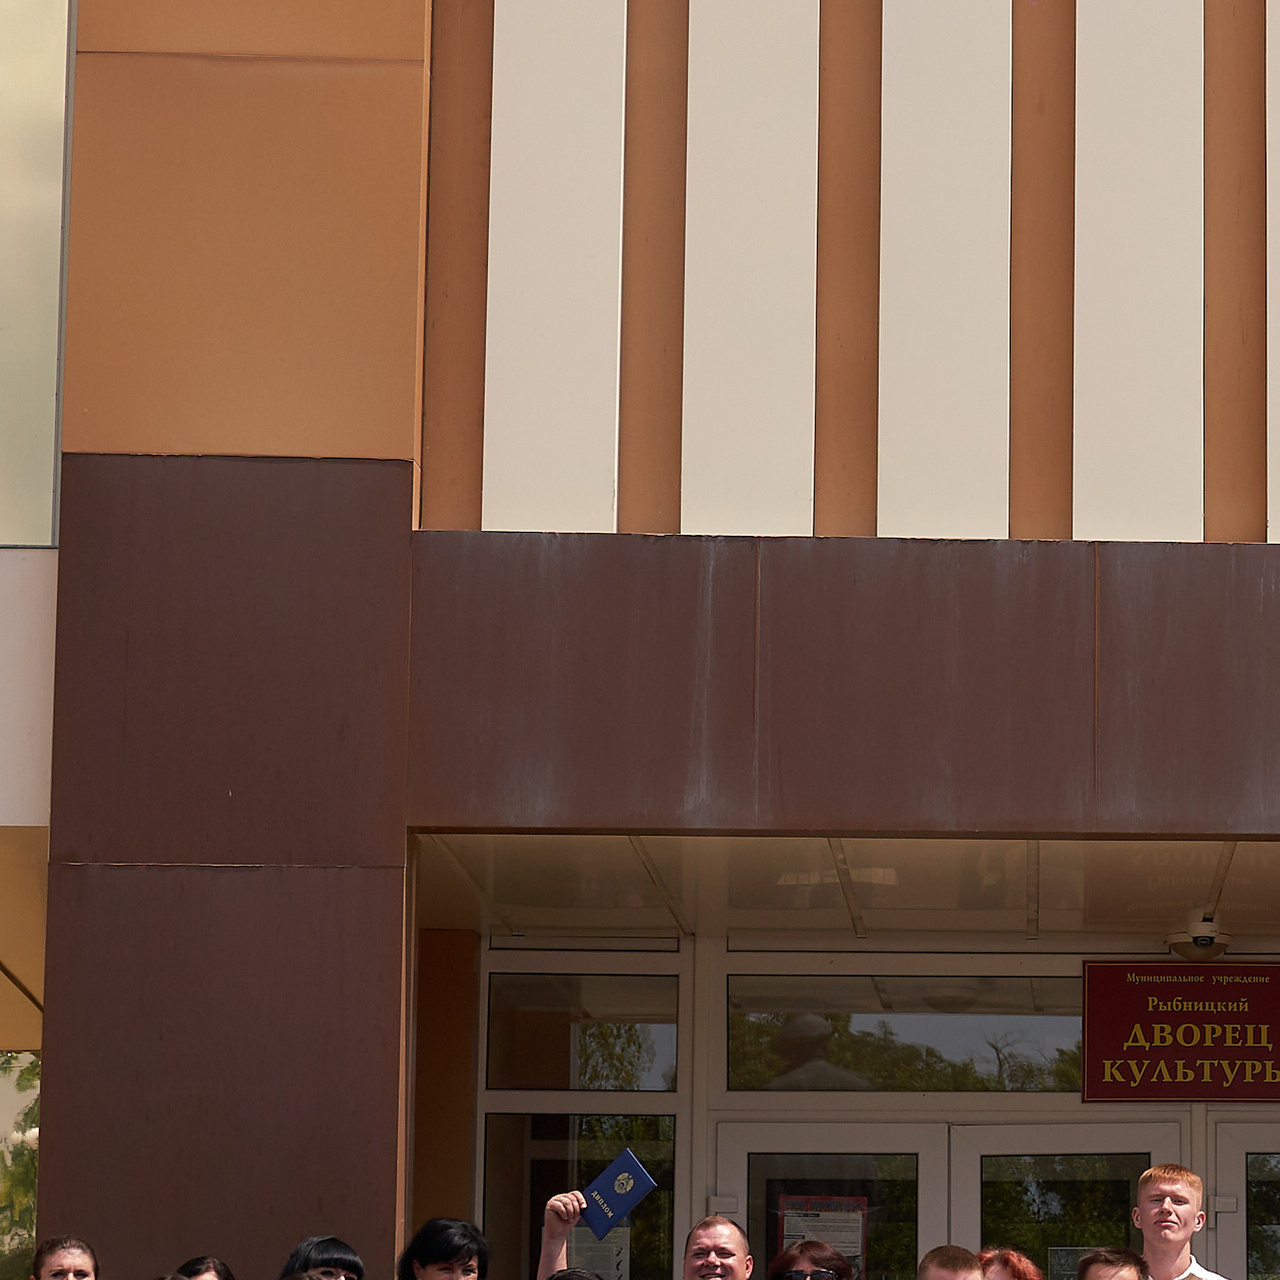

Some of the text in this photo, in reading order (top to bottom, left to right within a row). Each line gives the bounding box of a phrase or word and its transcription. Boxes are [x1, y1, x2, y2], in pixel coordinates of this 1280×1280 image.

[1126, 972, 1271, 985] Муниципальное учреждение
[1147, 996, 1250, 1014] Рыбницкий
[1122, 1023, 1274, 1052] ДВОРЕЦ
[590, 1190, 615, 1219] ДИПЛОМ
